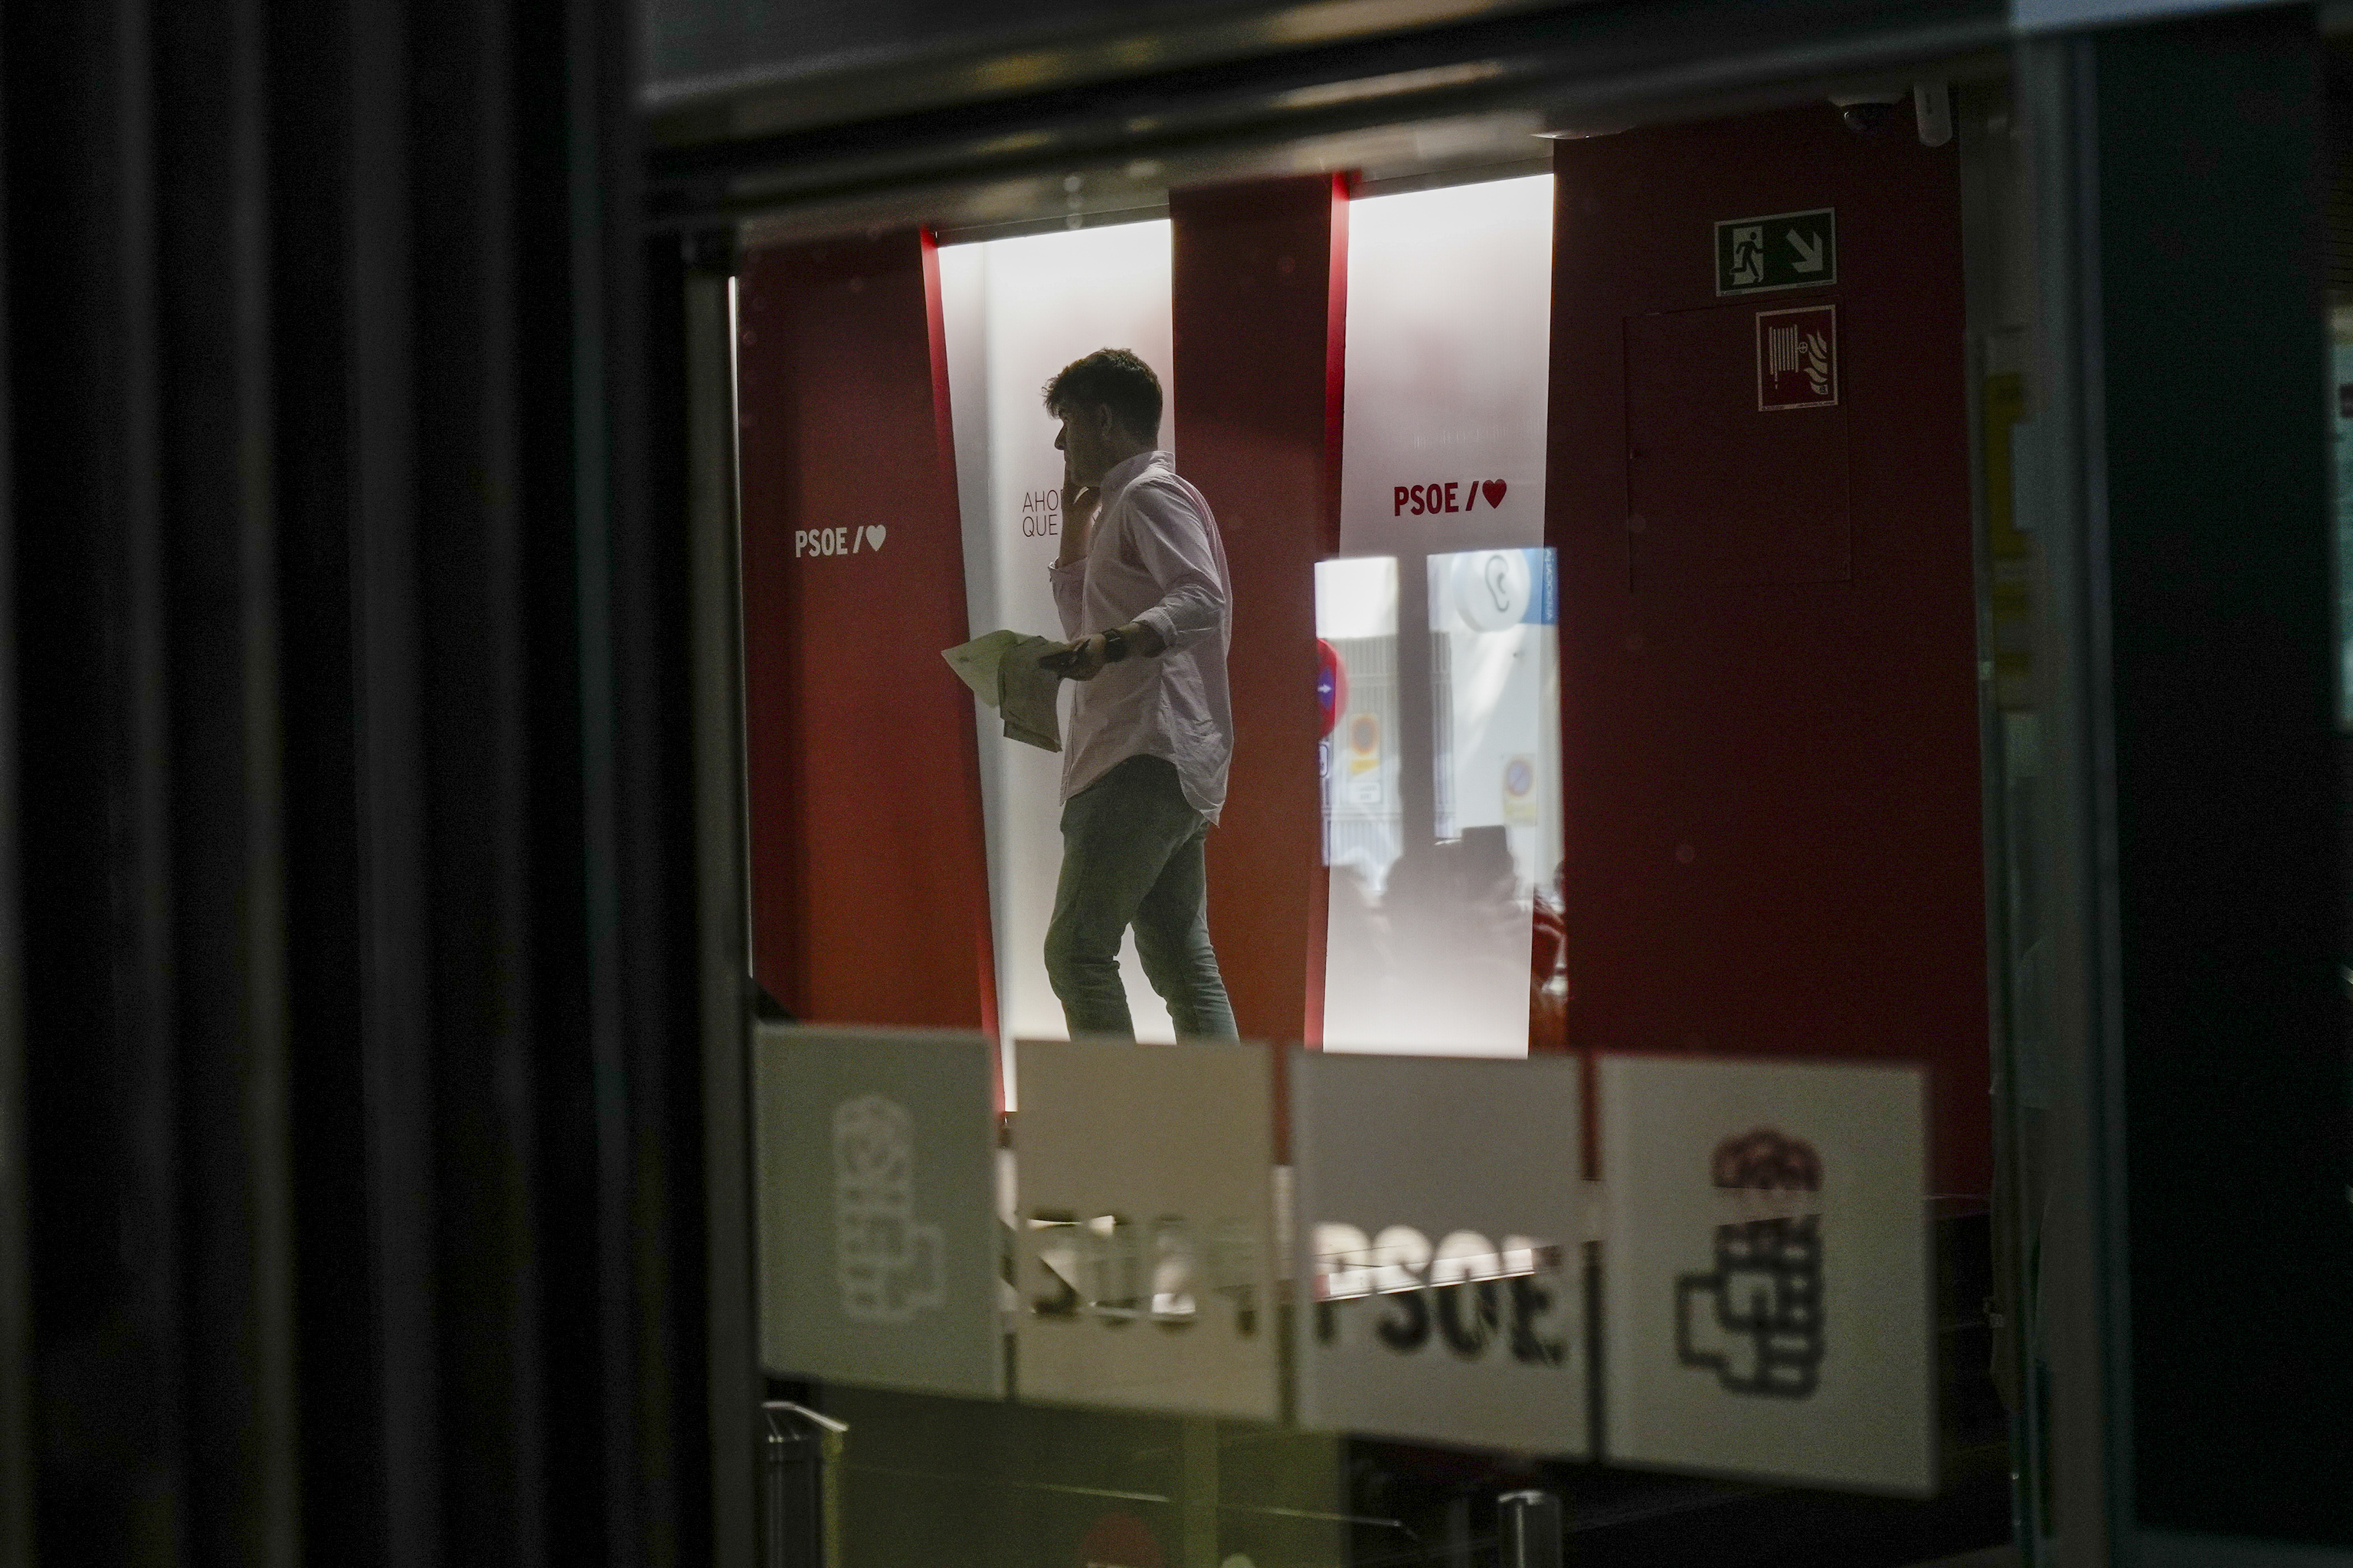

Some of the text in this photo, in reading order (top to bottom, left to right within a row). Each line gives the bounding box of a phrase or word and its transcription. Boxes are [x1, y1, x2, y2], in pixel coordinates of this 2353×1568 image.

[1022, 489, 1064, 512] AHO
[1394, 482, 1458, 516] PSOE
[1023, 514, 1058, 538] QUE
[795, 527, 848, 558] PSOE
